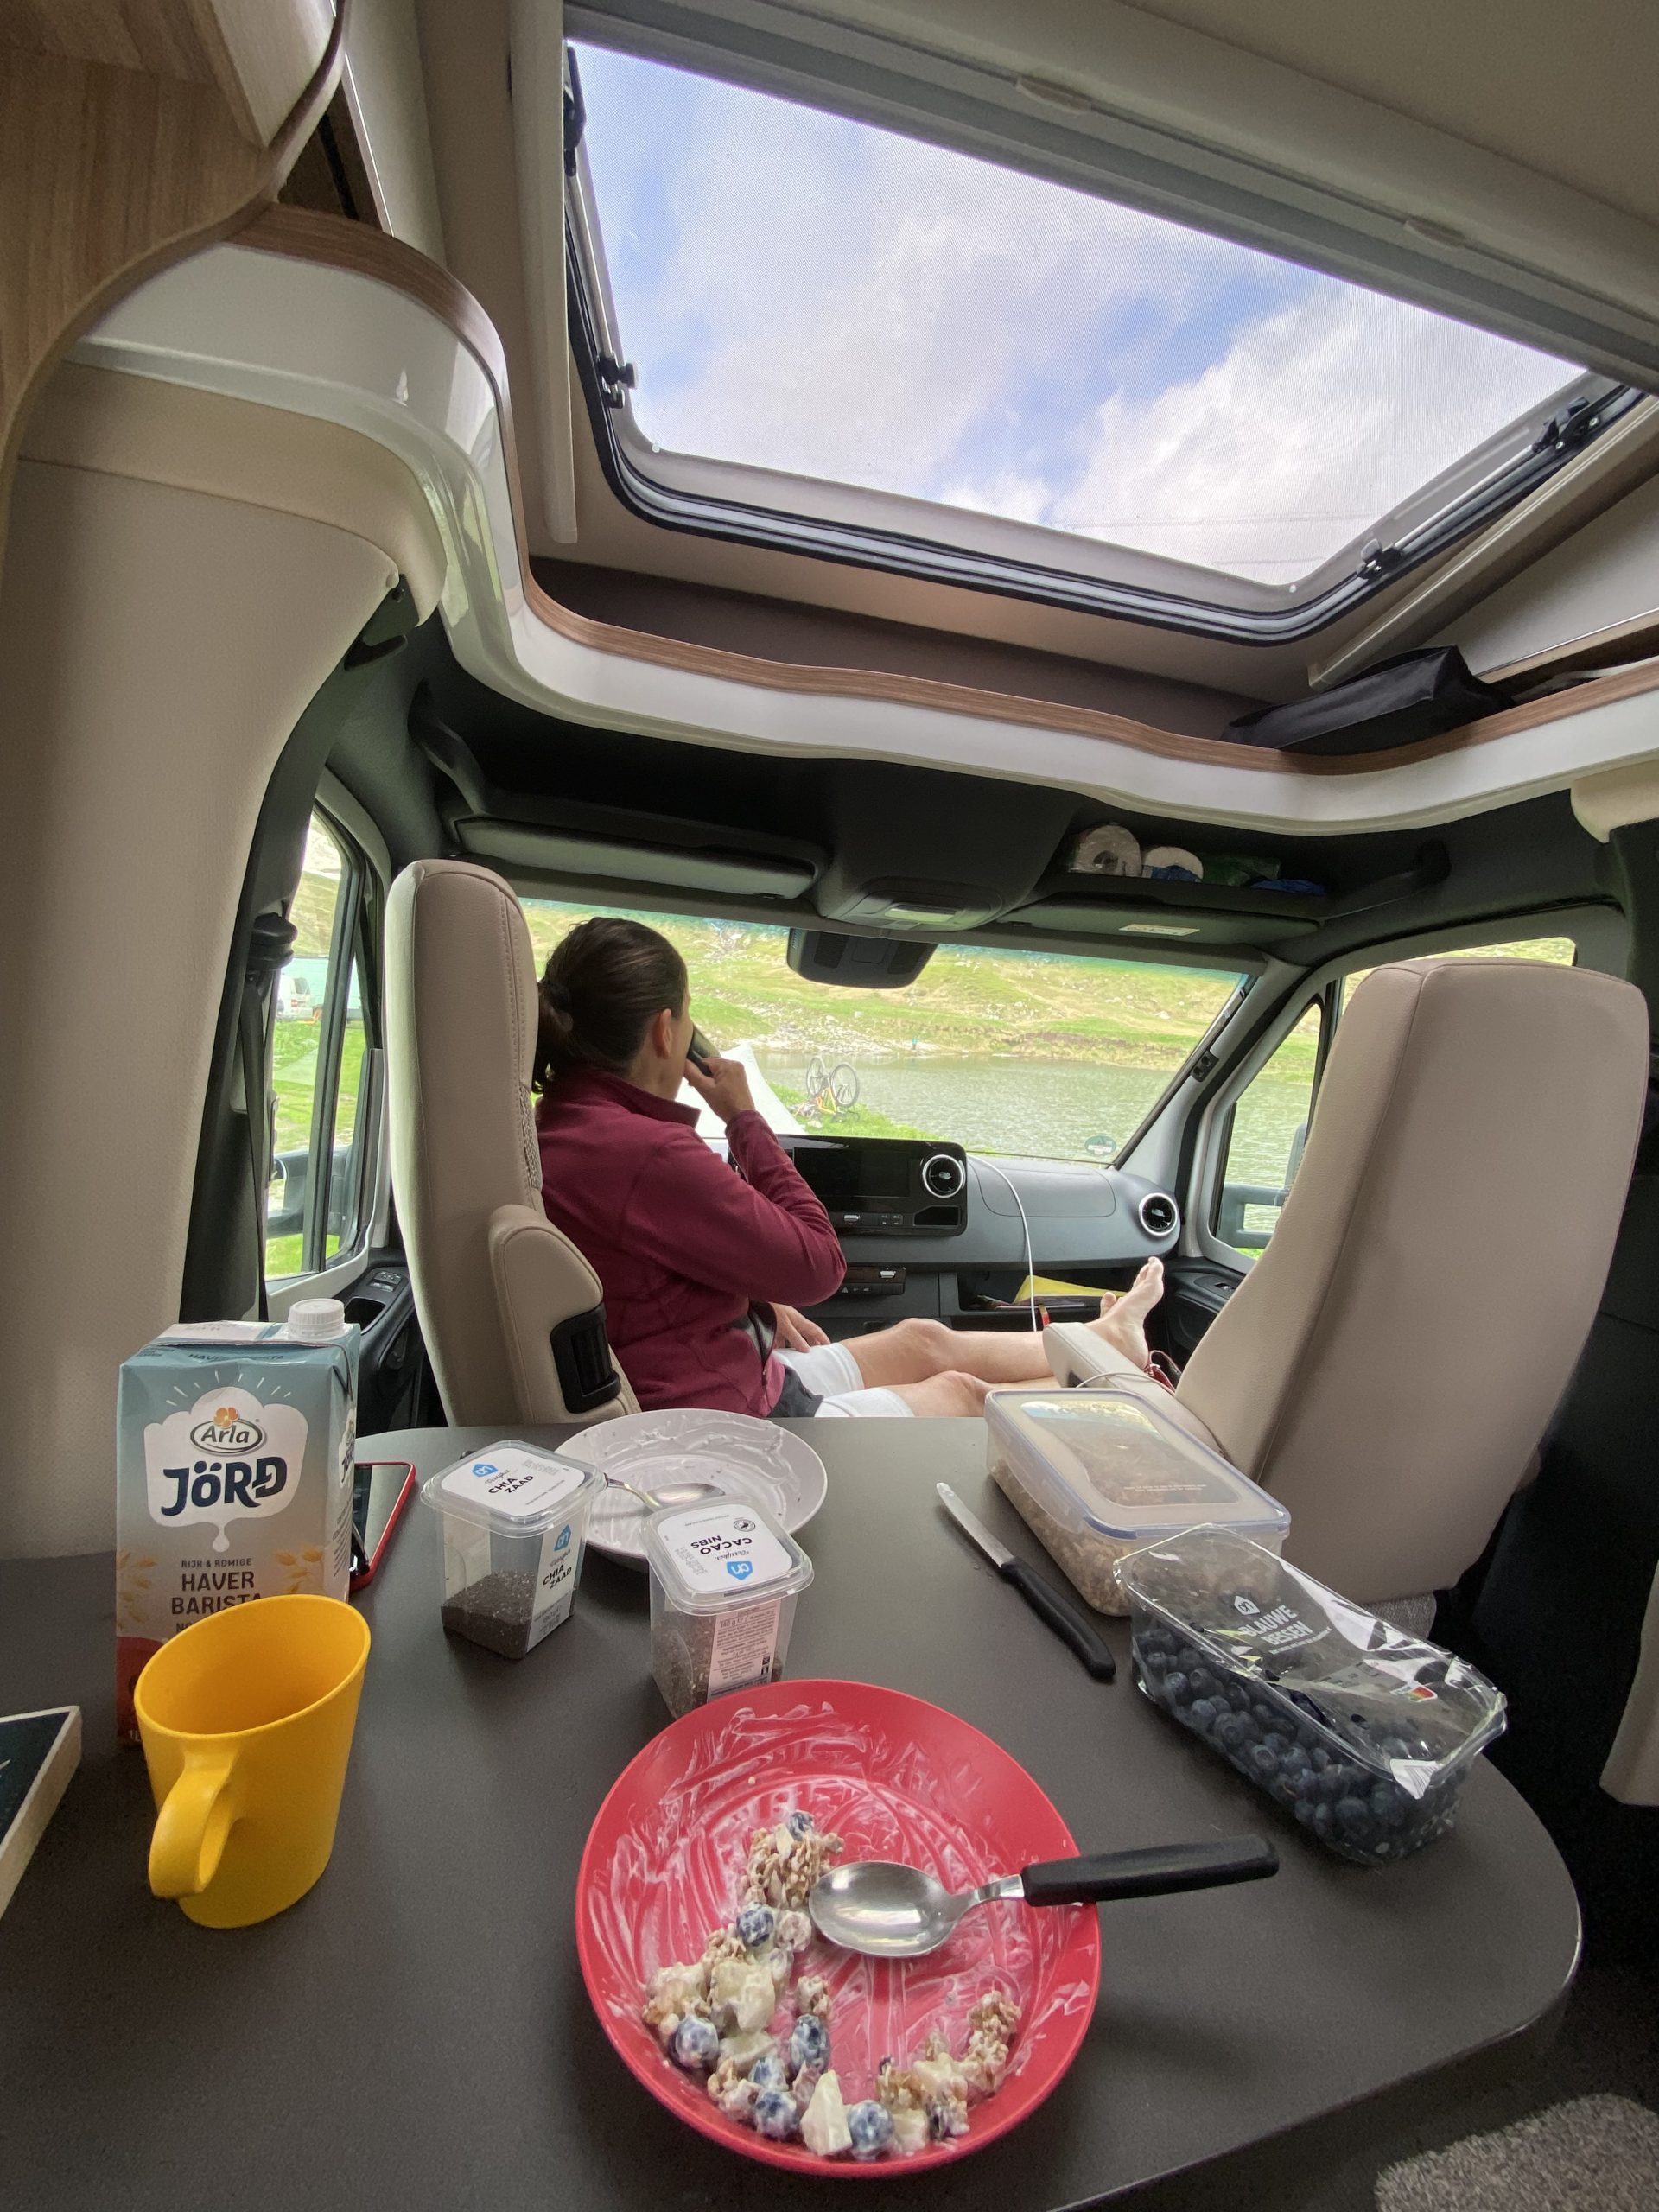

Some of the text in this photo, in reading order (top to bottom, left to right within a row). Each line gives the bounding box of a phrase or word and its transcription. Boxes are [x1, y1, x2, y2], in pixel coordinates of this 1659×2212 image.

[200, 1425, 250, 1444] Arla
[488, 1478, 518, 1494] CHIA
[504, 1475, 534, 1493] ZAAD
[690, 1535, 722, 1549] NIBS
[700, 1537, 753, 1554] CACAO
[206, 1560, 212, 1568] &
[214, 1558, 252, 1567] ROMIGE
[181, 1571, 255, 1592] HAVER
[543, 1564, 564, 1586] CHIA
[550, 1567, 572, 1590] ZAAD
[1238, 1604, 1298, 1637] BLAUWE
